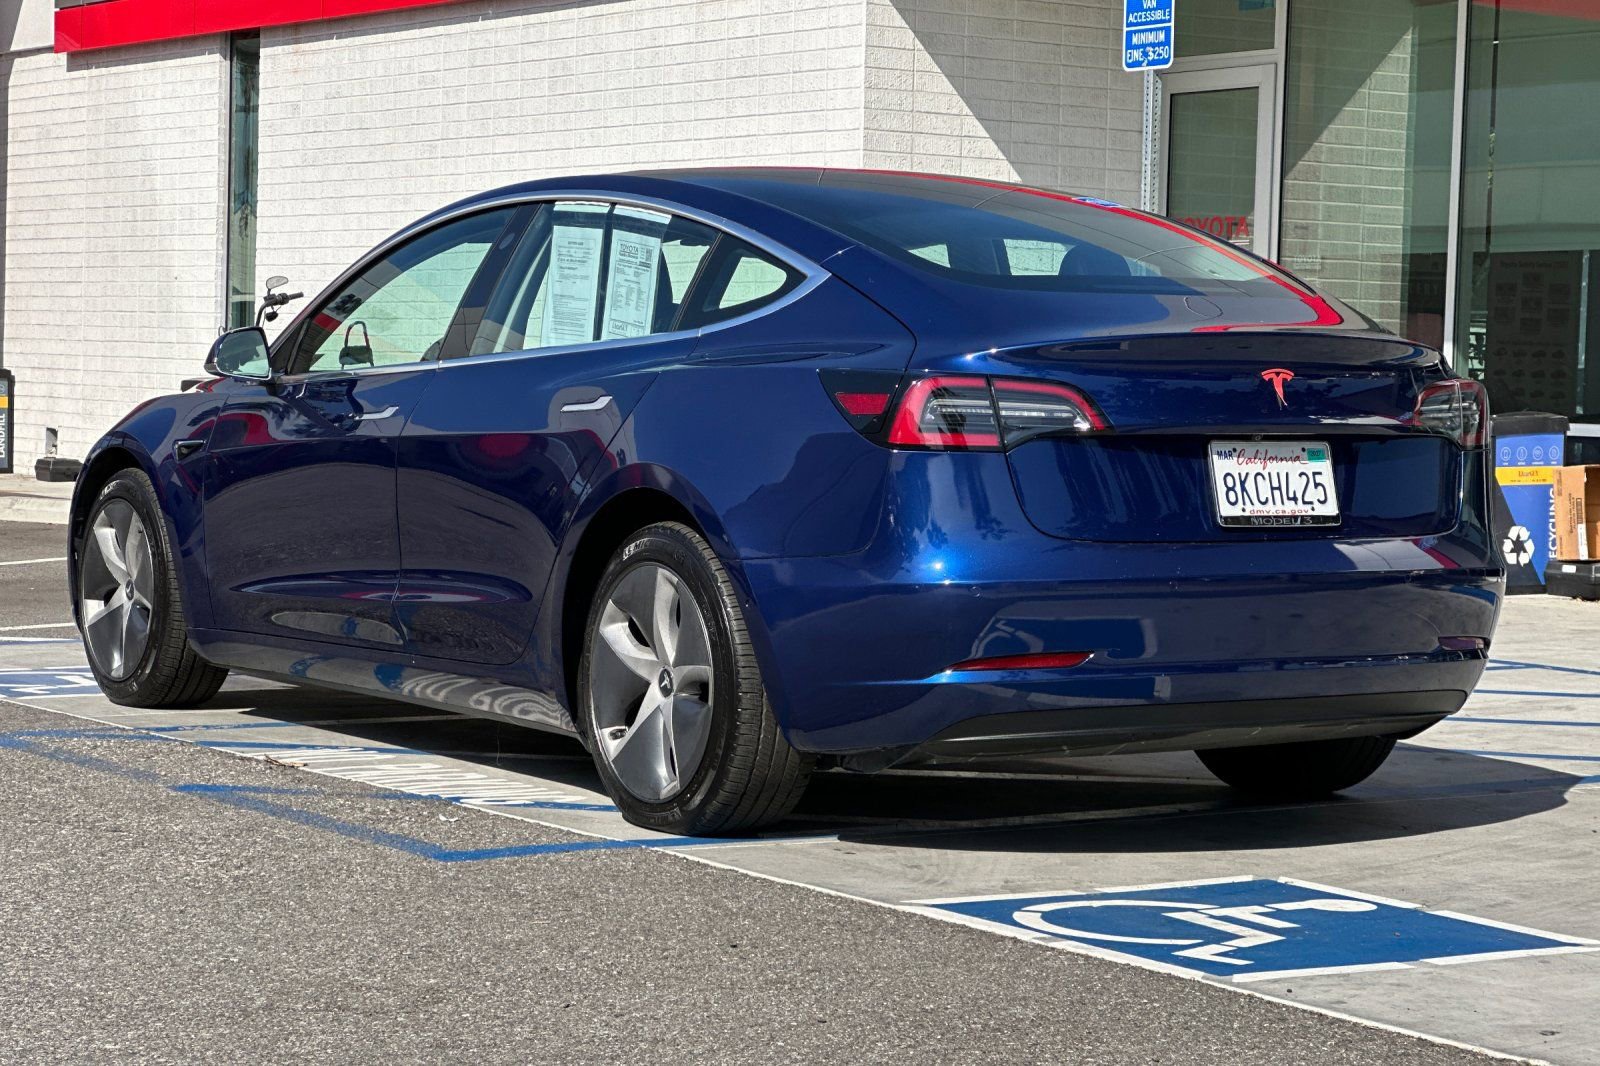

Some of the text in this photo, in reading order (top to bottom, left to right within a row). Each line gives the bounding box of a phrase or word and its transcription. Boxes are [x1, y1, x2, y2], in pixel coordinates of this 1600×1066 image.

[1142, 0, 1157, 9] VAN
[1127, 9, 1170, 23] ACCESSIBLE
[1132, 30, 1165, 45] MINIMUM
[1146, 46, 1169, 61] $250
[1181, 215, 1249, 237] YOTA
[1216, 449, 1233, 460] MAR
[1237, 448, 1308, 470] California
[1223, 471, 1328, 506] 8KCH425
[1549, 487, 1557, 559] ECYCLIN
